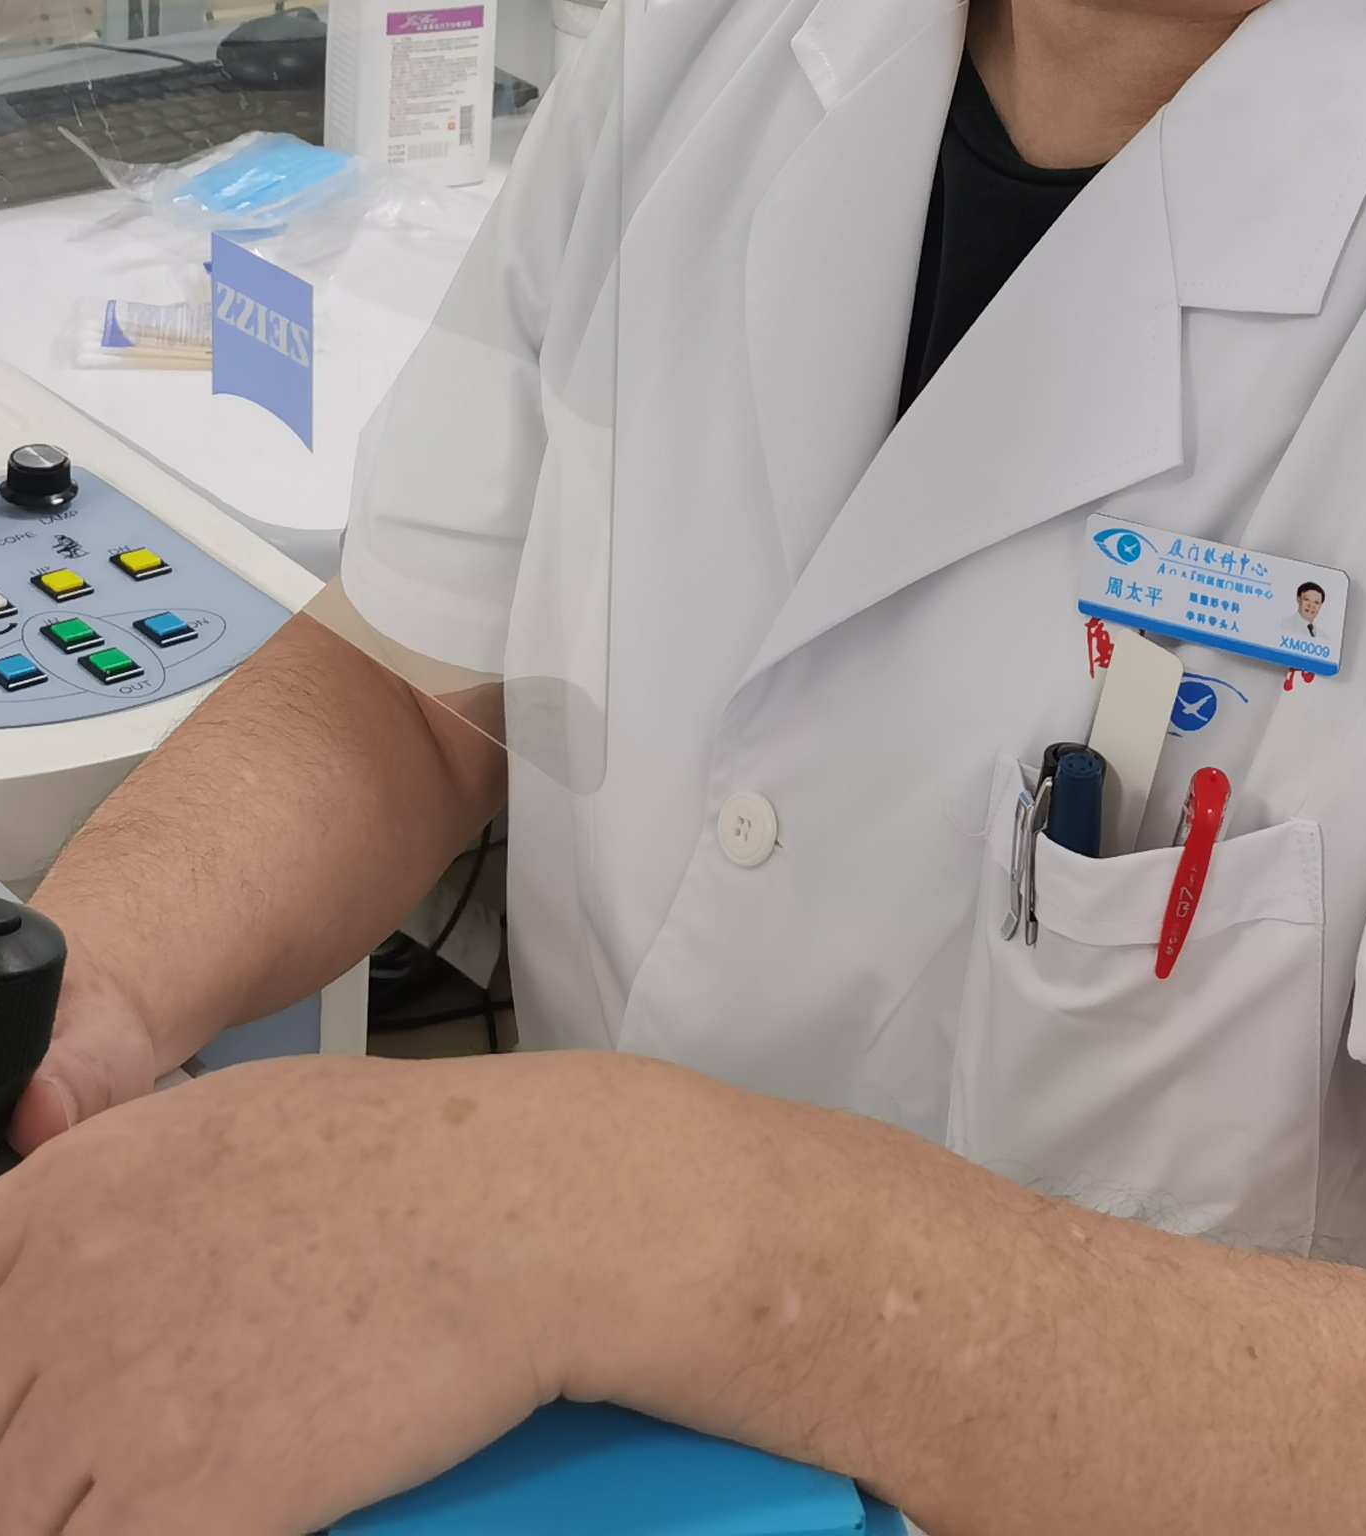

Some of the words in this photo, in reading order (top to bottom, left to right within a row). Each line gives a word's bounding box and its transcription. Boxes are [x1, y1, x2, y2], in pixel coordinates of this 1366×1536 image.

[1104, 575, 1164, 607] 周太平
[1278, 635, 1332, 659] XM0009
[119, 679, 152, 695] OUT
